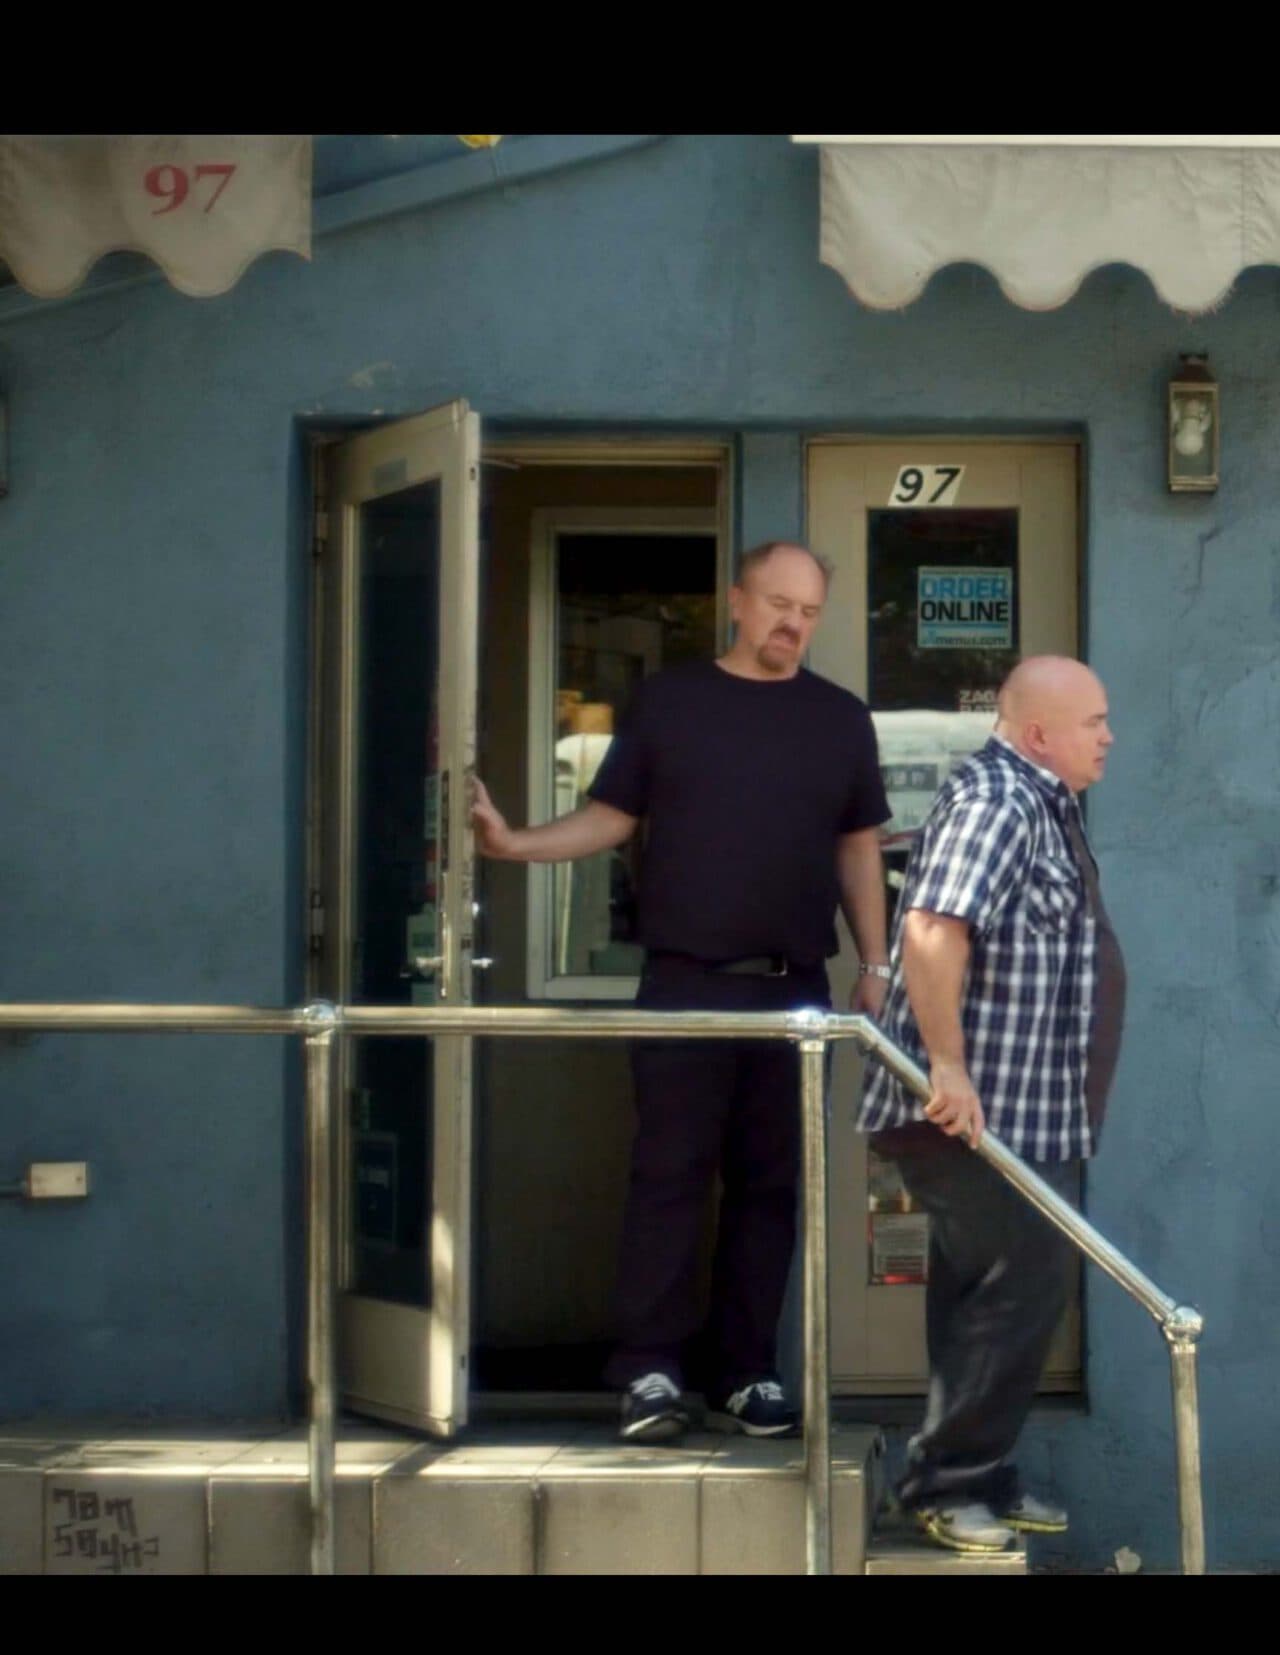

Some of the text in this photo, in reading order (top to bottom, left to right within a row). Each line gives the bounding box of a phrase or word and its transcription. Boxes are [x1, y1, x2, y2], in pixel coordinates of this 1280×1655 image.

[144, 163, 237, 216] 97
[895, 467, 961, 503] 97
[921, 577, 1008, 599] ORDER
[921, 600, 1008, 622] ONLINE
